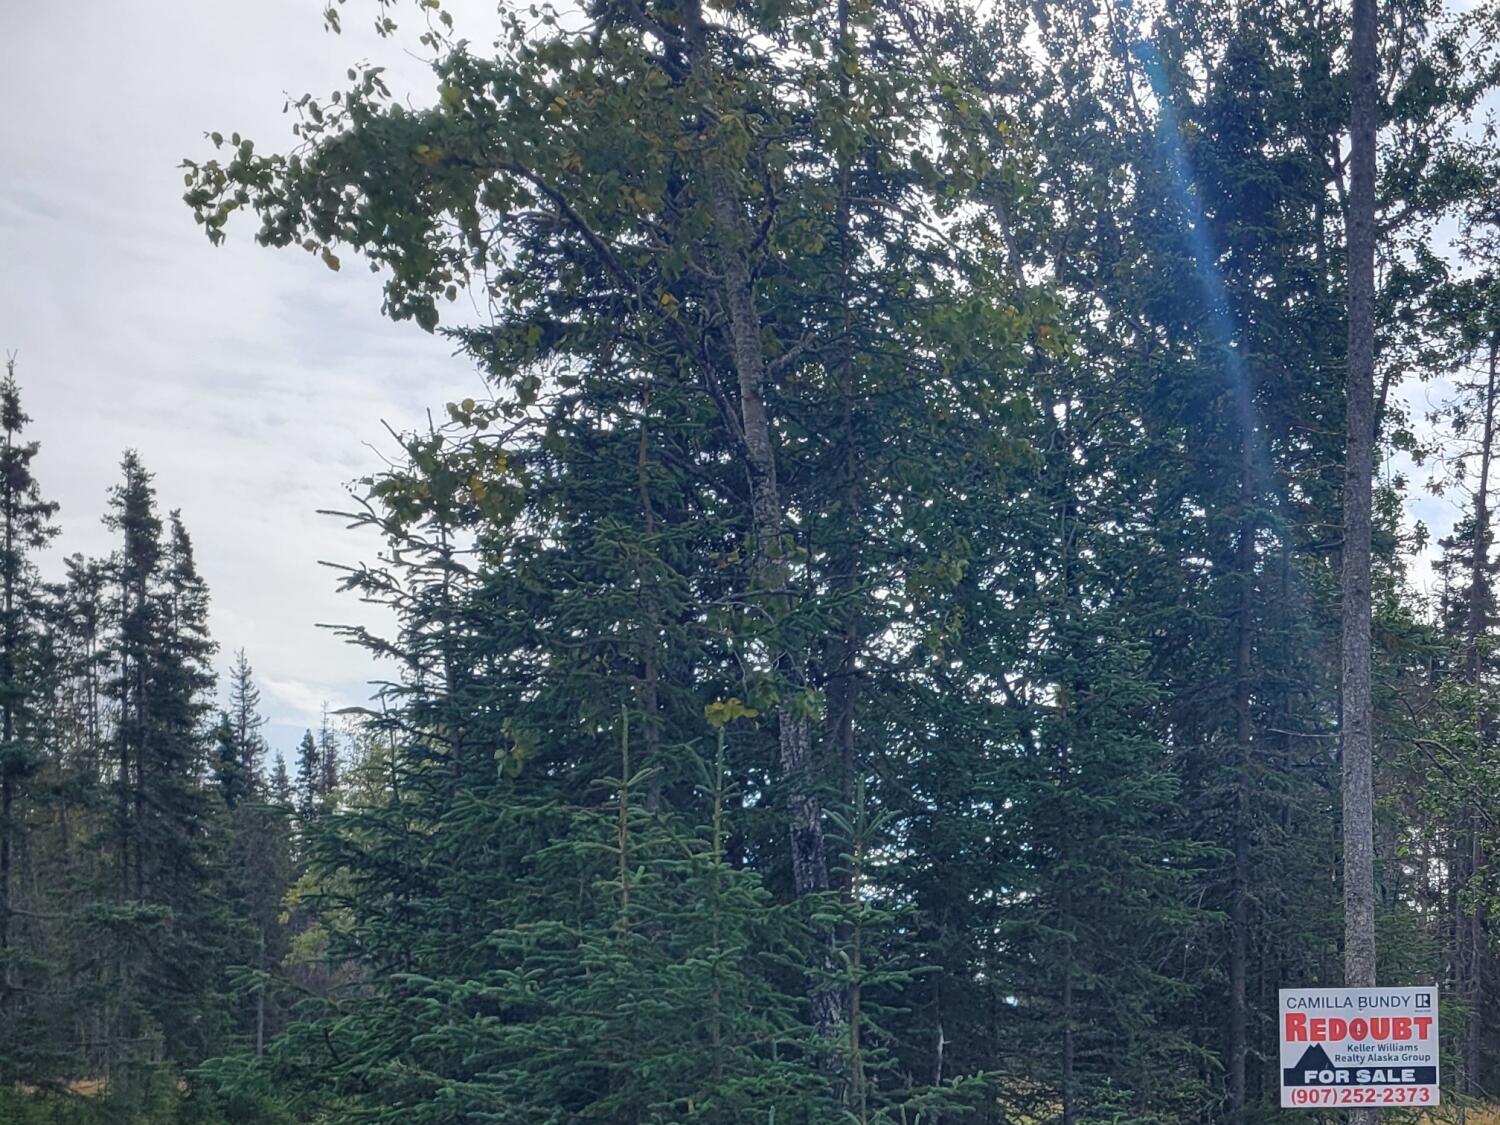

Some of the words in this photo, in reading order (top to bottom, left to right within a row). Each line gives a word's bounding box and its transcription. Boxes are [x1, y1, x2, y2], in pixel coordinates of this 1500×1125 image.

[1287, 997, 1353, 1008] CAMILLA
[1358, 996, 1411, 1008] BUNDY
[1286, 1013, 1432, 1041] REDOUBT
[1377, 1043, 1418, 1052] Williams
[1335, 1054, 1365, 1064] Realty
[1368, 1054, 1399, 1062] Alaska
[1402, 1053, 1431, 1062] Group
[1304, 1070, 1349, 1083] FOR
[1356, 1069, 1415, 1083] SALE
[1291, 1089, 1338, 1104] (907)
[1341, 1088, 1430, 1103] 252-2373
